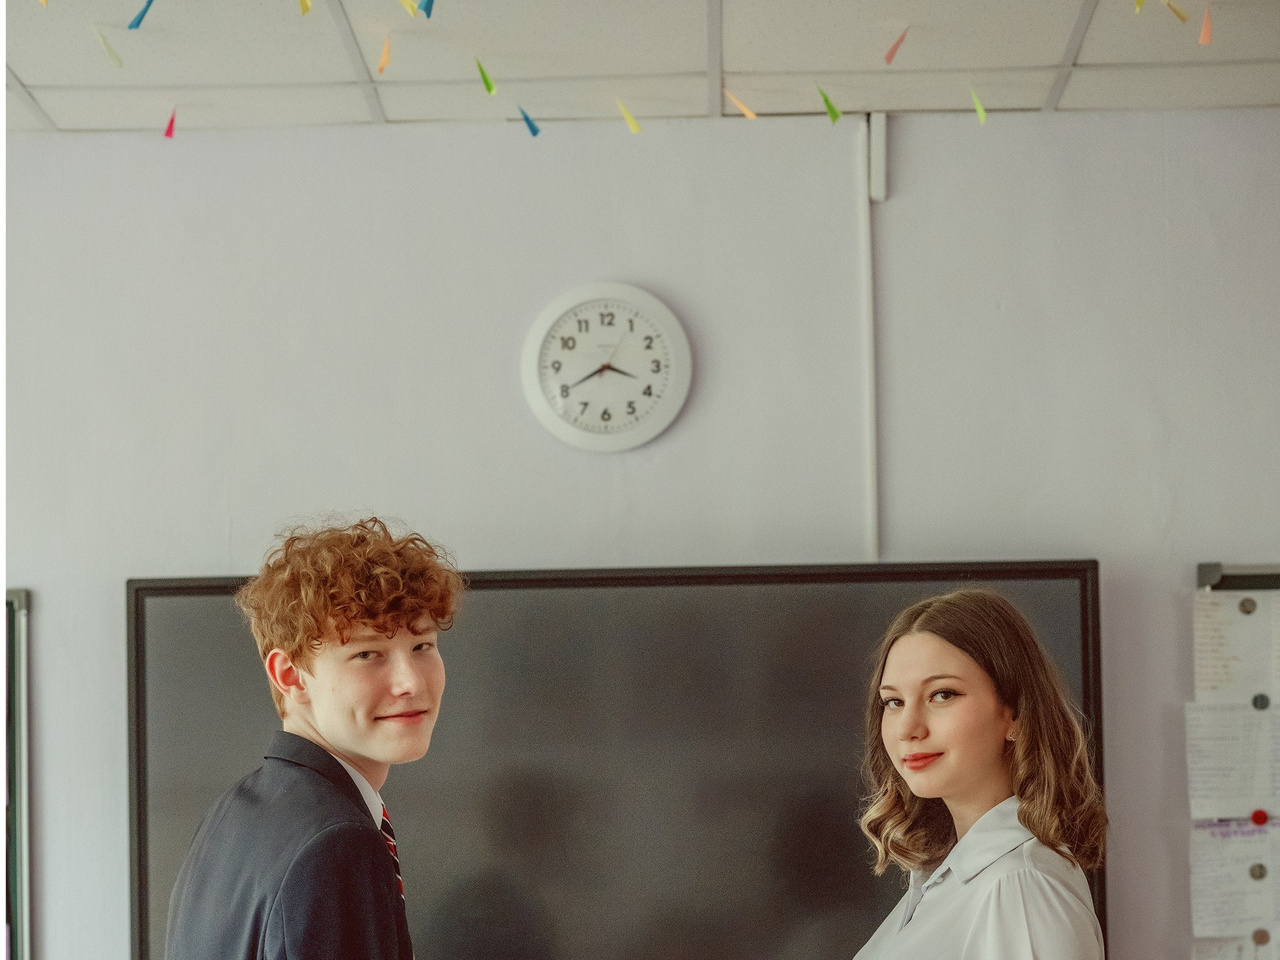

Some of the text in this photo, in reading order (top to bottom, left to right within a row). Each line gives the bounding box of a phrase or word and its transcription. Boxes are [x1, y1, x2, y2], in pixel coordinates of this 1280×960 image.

[577, 319, 589, 332] 11
[599, 312, 615, 326] 12
[628, 319, 634, 332] 1
[561, 336, 576, 350] 10
[644, 336, 654, 350] 2
[552, 360, 562, 374] 9
[651, 360, 661, 374] 3
[560, 384, 570, 398] 8
[642, 385, 653, 398] 4
[579, 402, 589, 415] 7
[600, 408, 612, 422] 6
[626, 401, 636, 415] 5
